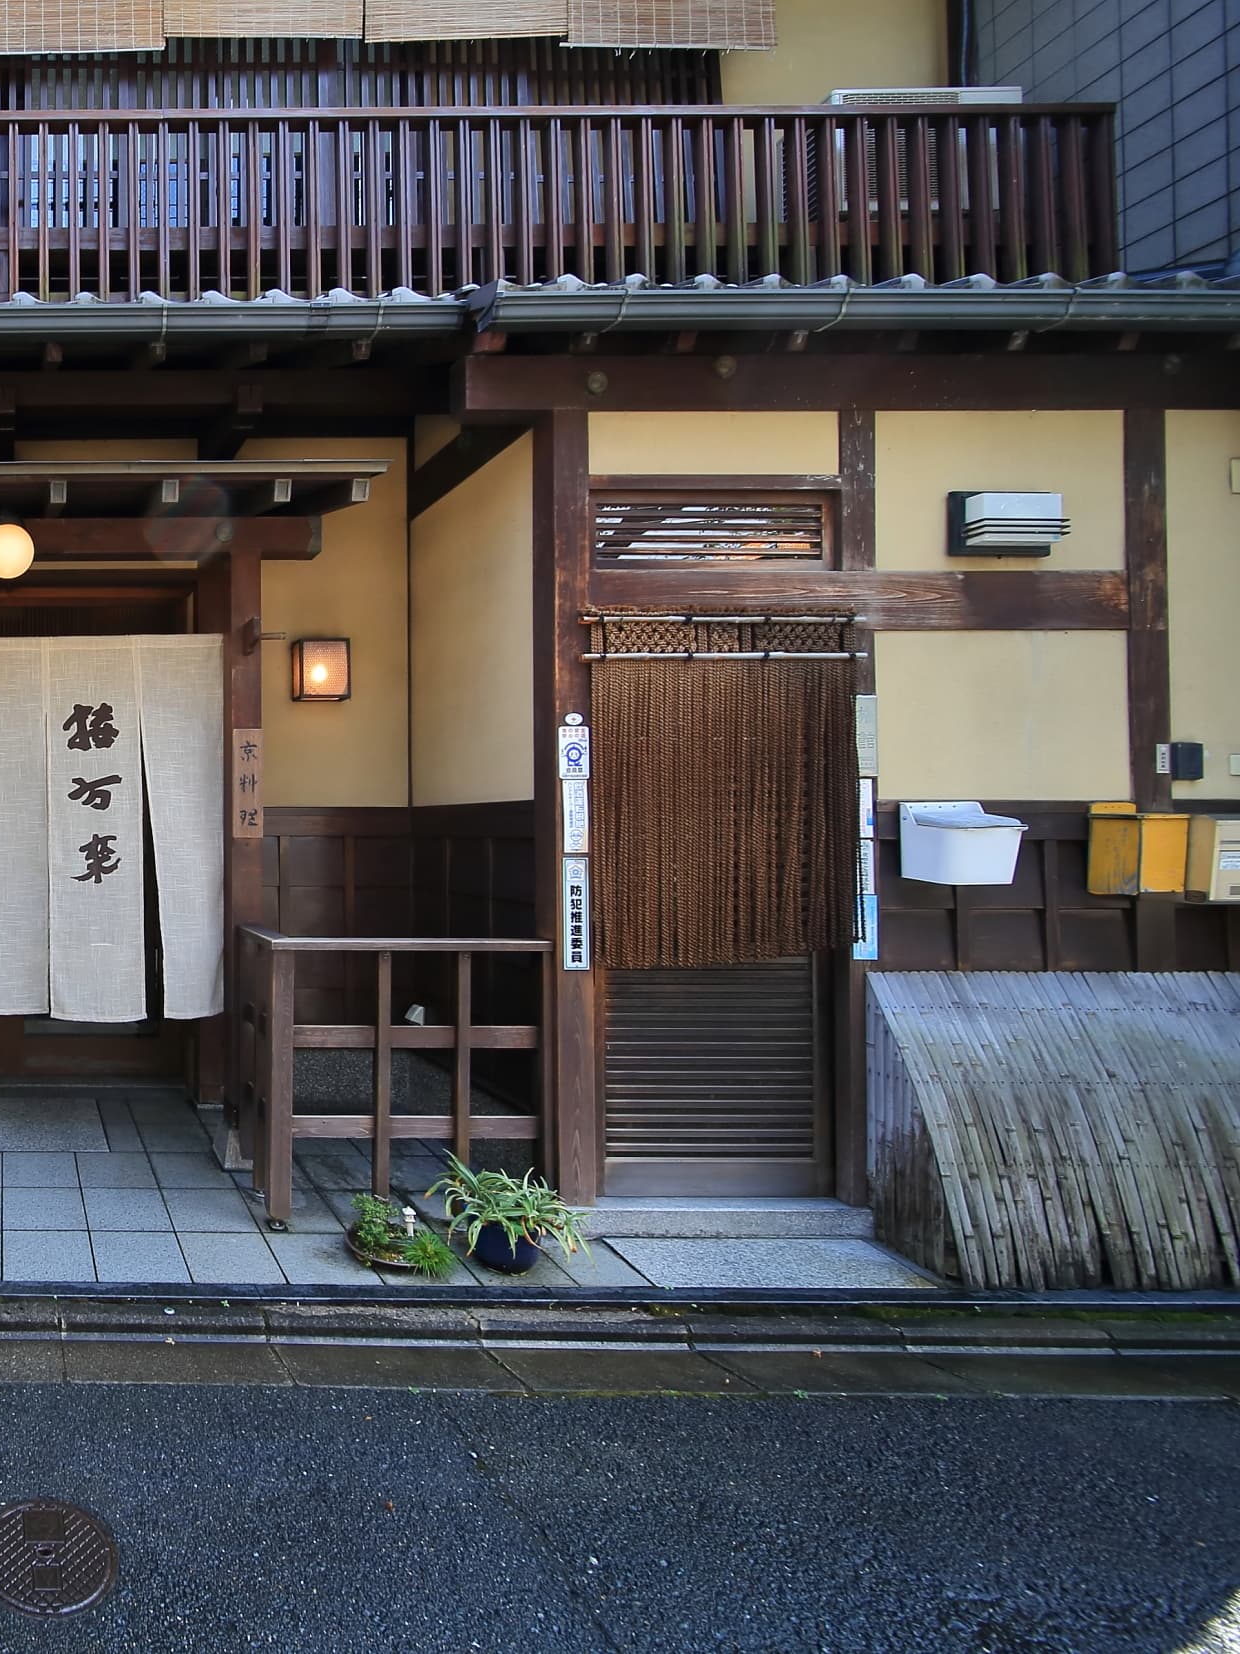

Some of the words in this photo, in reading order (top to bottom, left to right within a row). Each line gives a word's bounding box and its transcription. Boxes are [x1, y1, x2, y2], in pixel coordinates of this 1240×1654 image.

[239, 740, 258, 826] 京料理
[570, 885, 583, 963] 防犯推進委員
